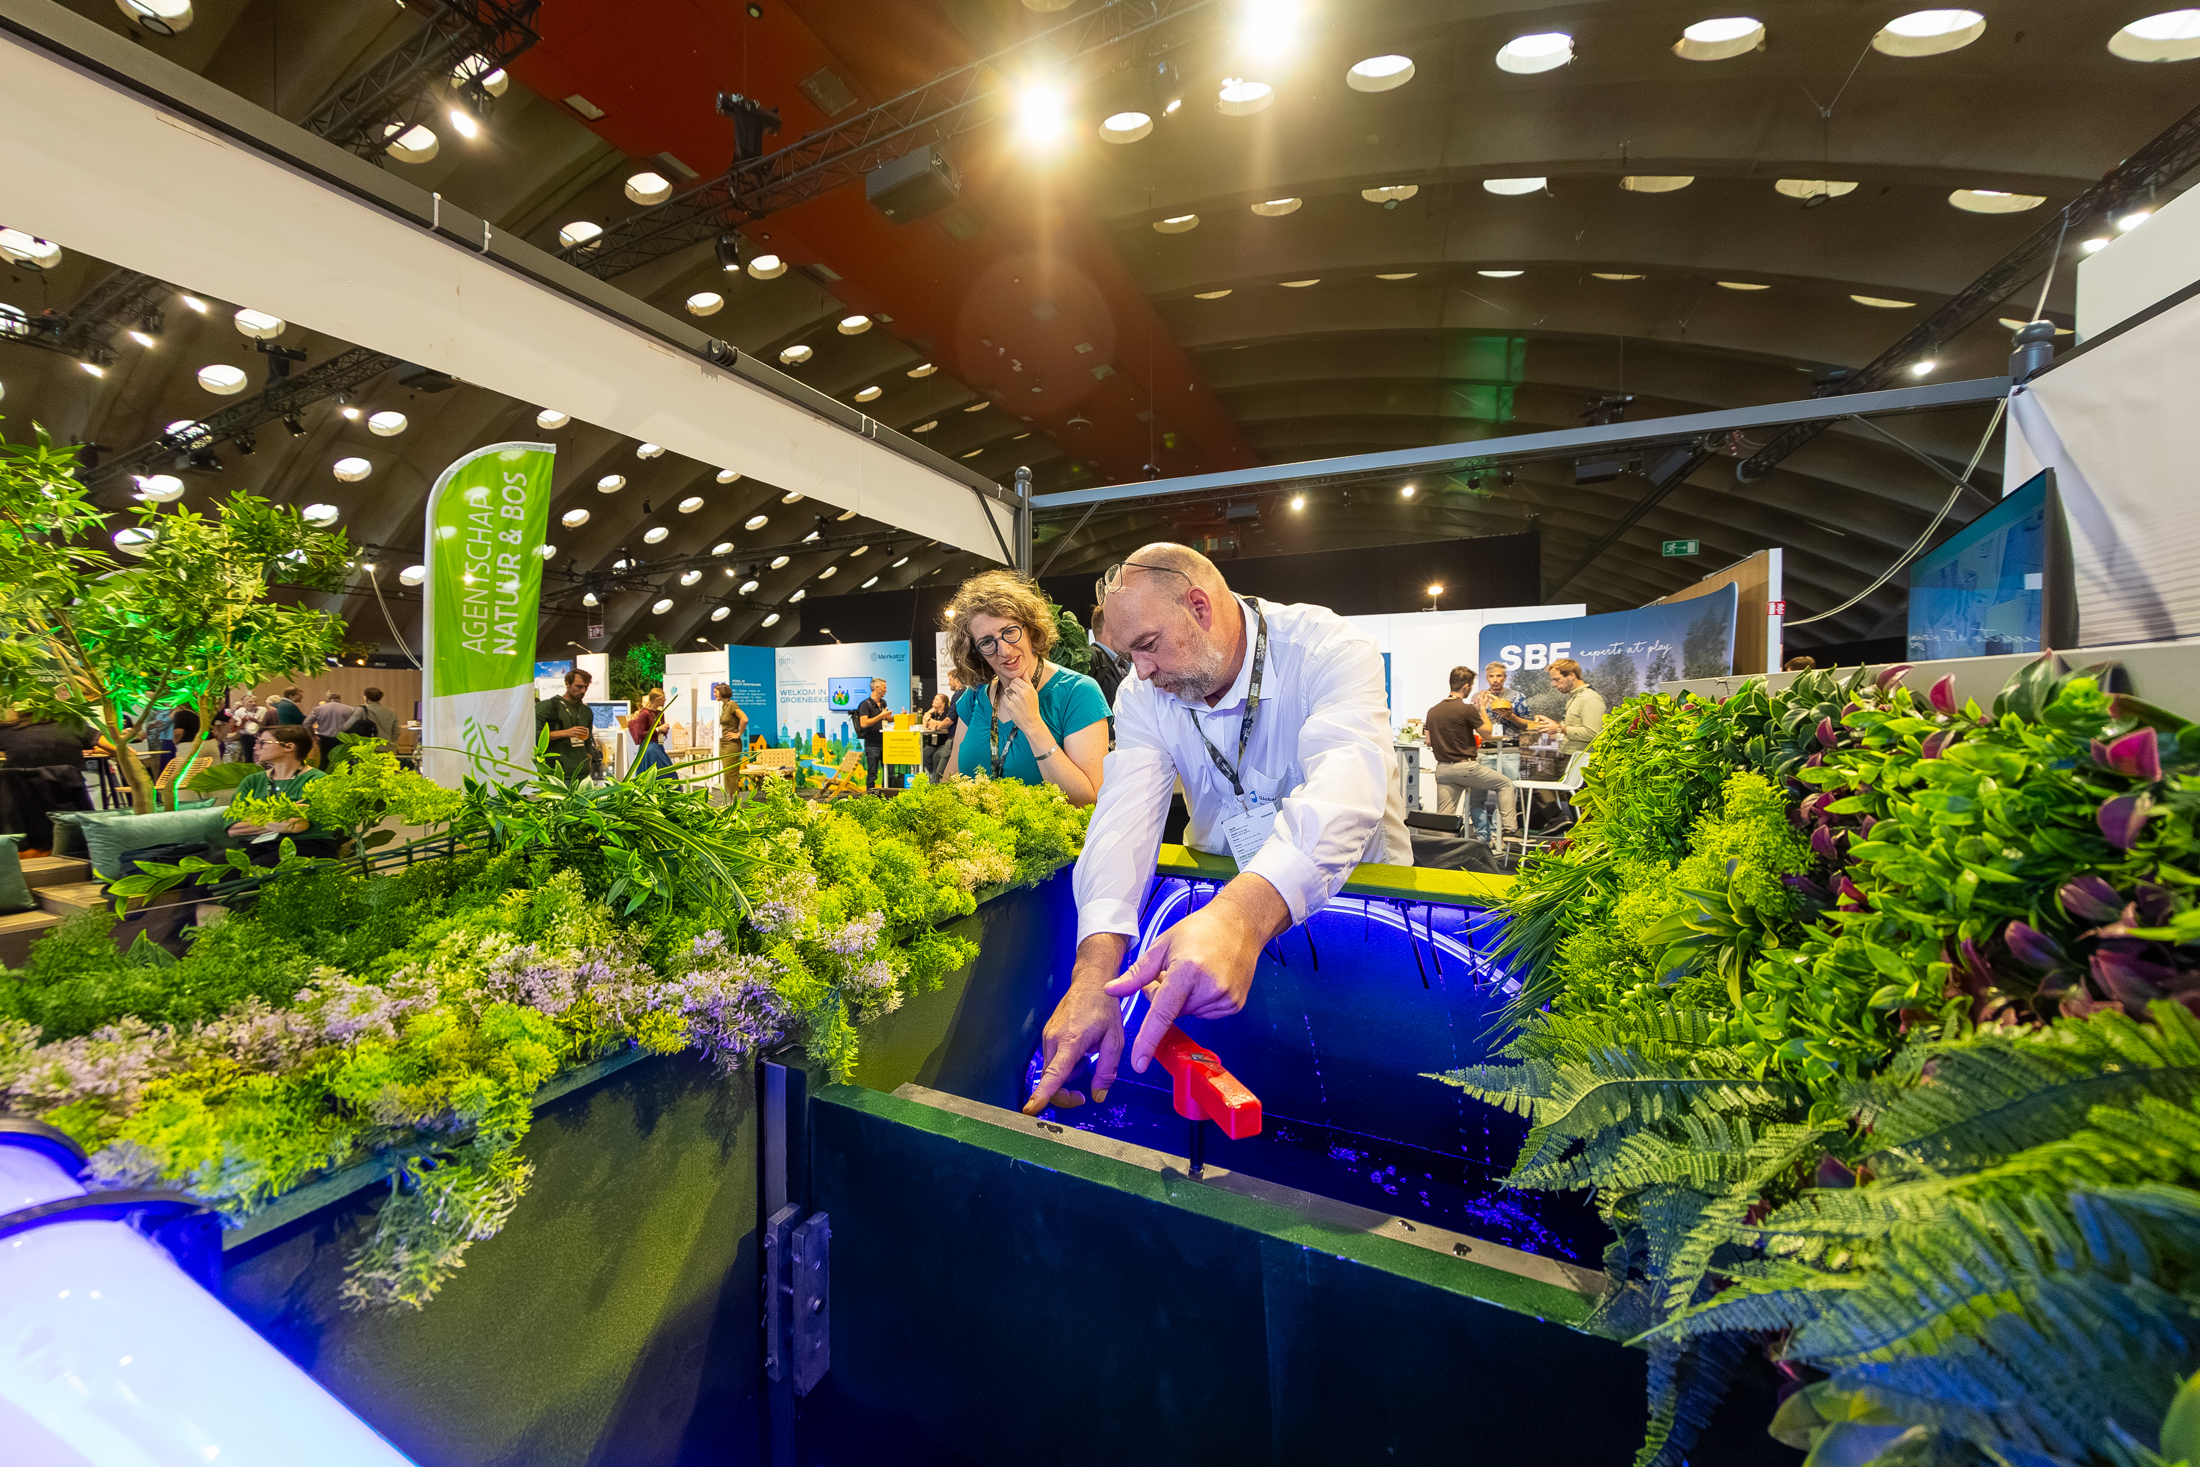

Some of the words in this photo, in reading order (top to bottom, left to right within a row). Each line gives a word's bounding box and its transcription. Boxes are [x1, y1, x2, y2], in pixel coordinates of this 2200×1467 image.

[501, 472, 528, 521] BOS
[498, 529, 523, 545] &
[462, 493, 494, 655] AGENTSCHAP
[493, 553, 521, 656] NATUUR
[1579, 642, 1625, 664] experts
[1626, 641, 1648, 653] at
[1646, 639, 1673, 660] play
[779, 688, 816, 696] WELKOM
